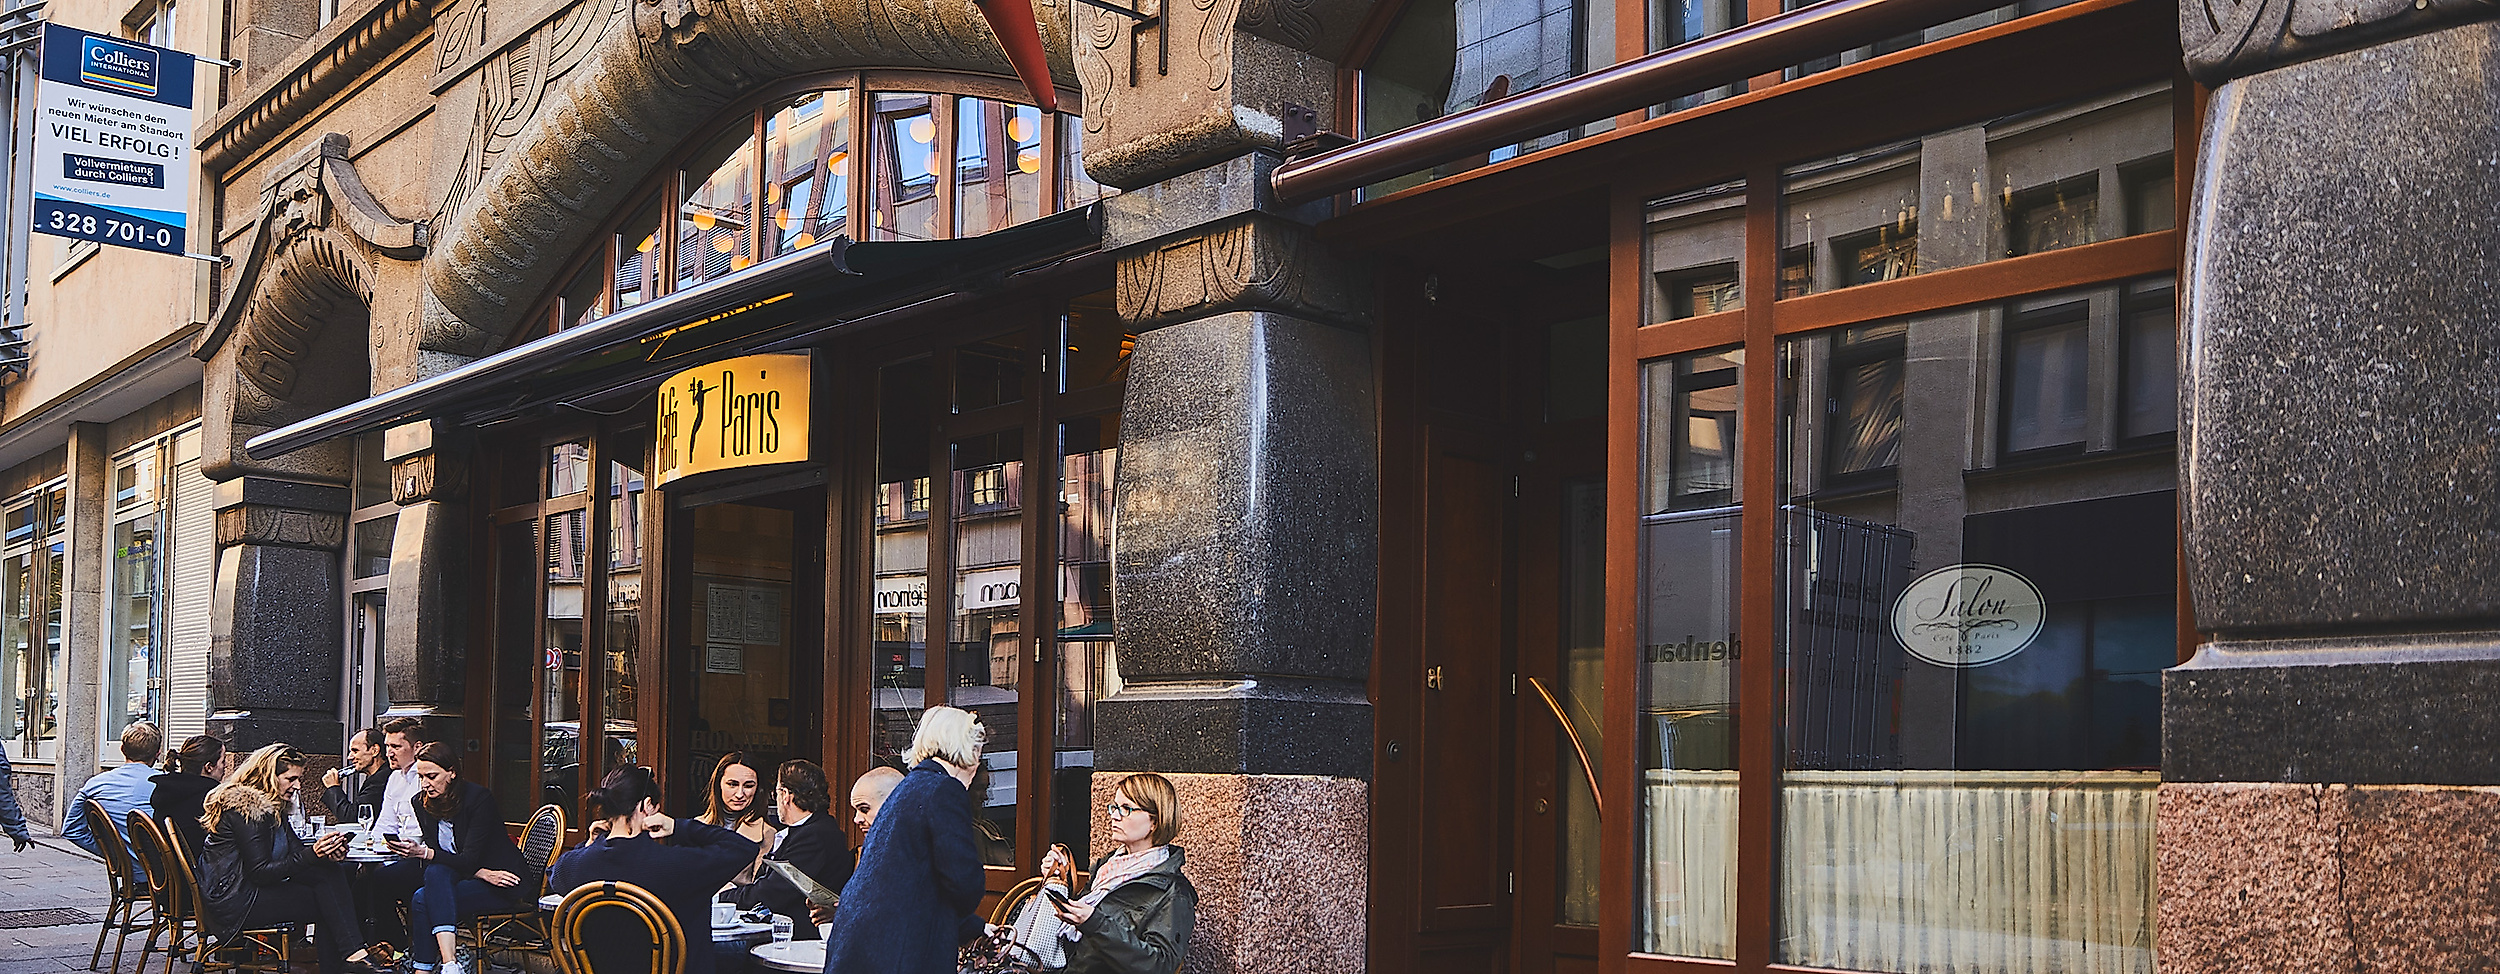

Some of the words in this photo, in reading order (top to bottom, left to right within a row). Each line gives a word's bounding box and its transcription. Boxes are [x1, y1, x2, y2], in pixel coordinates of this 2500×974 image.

[91, 46, 150, 71] Colliers
[91, 61, 149, 78] INTERNATIONAL
[48, 107, 81, 120] neuen
[85, 113, 118, 127] Mieter
[121, 122, 136, 131] am
[139, 123, 184, 140] Standort
[67, 97, 86, 109] Wir
[89, 102, 141, 119] wünschen
[145, 113, 167, 125] dem
[51, 122, 93, 144] VIEL
[99, 131, 170, 158] ERFOLG
[74, 157, 154, 176] Vollvermietung
[74, 168, 106, 179] durch
[53, 183, 111, 199] www.colliers.de
[49, 210, 97, 235] 328
[105, 219, 172, 247] 701-0
[720, 369, 781, 459] Paris
[1915, 574, 2010, 621] Salon
